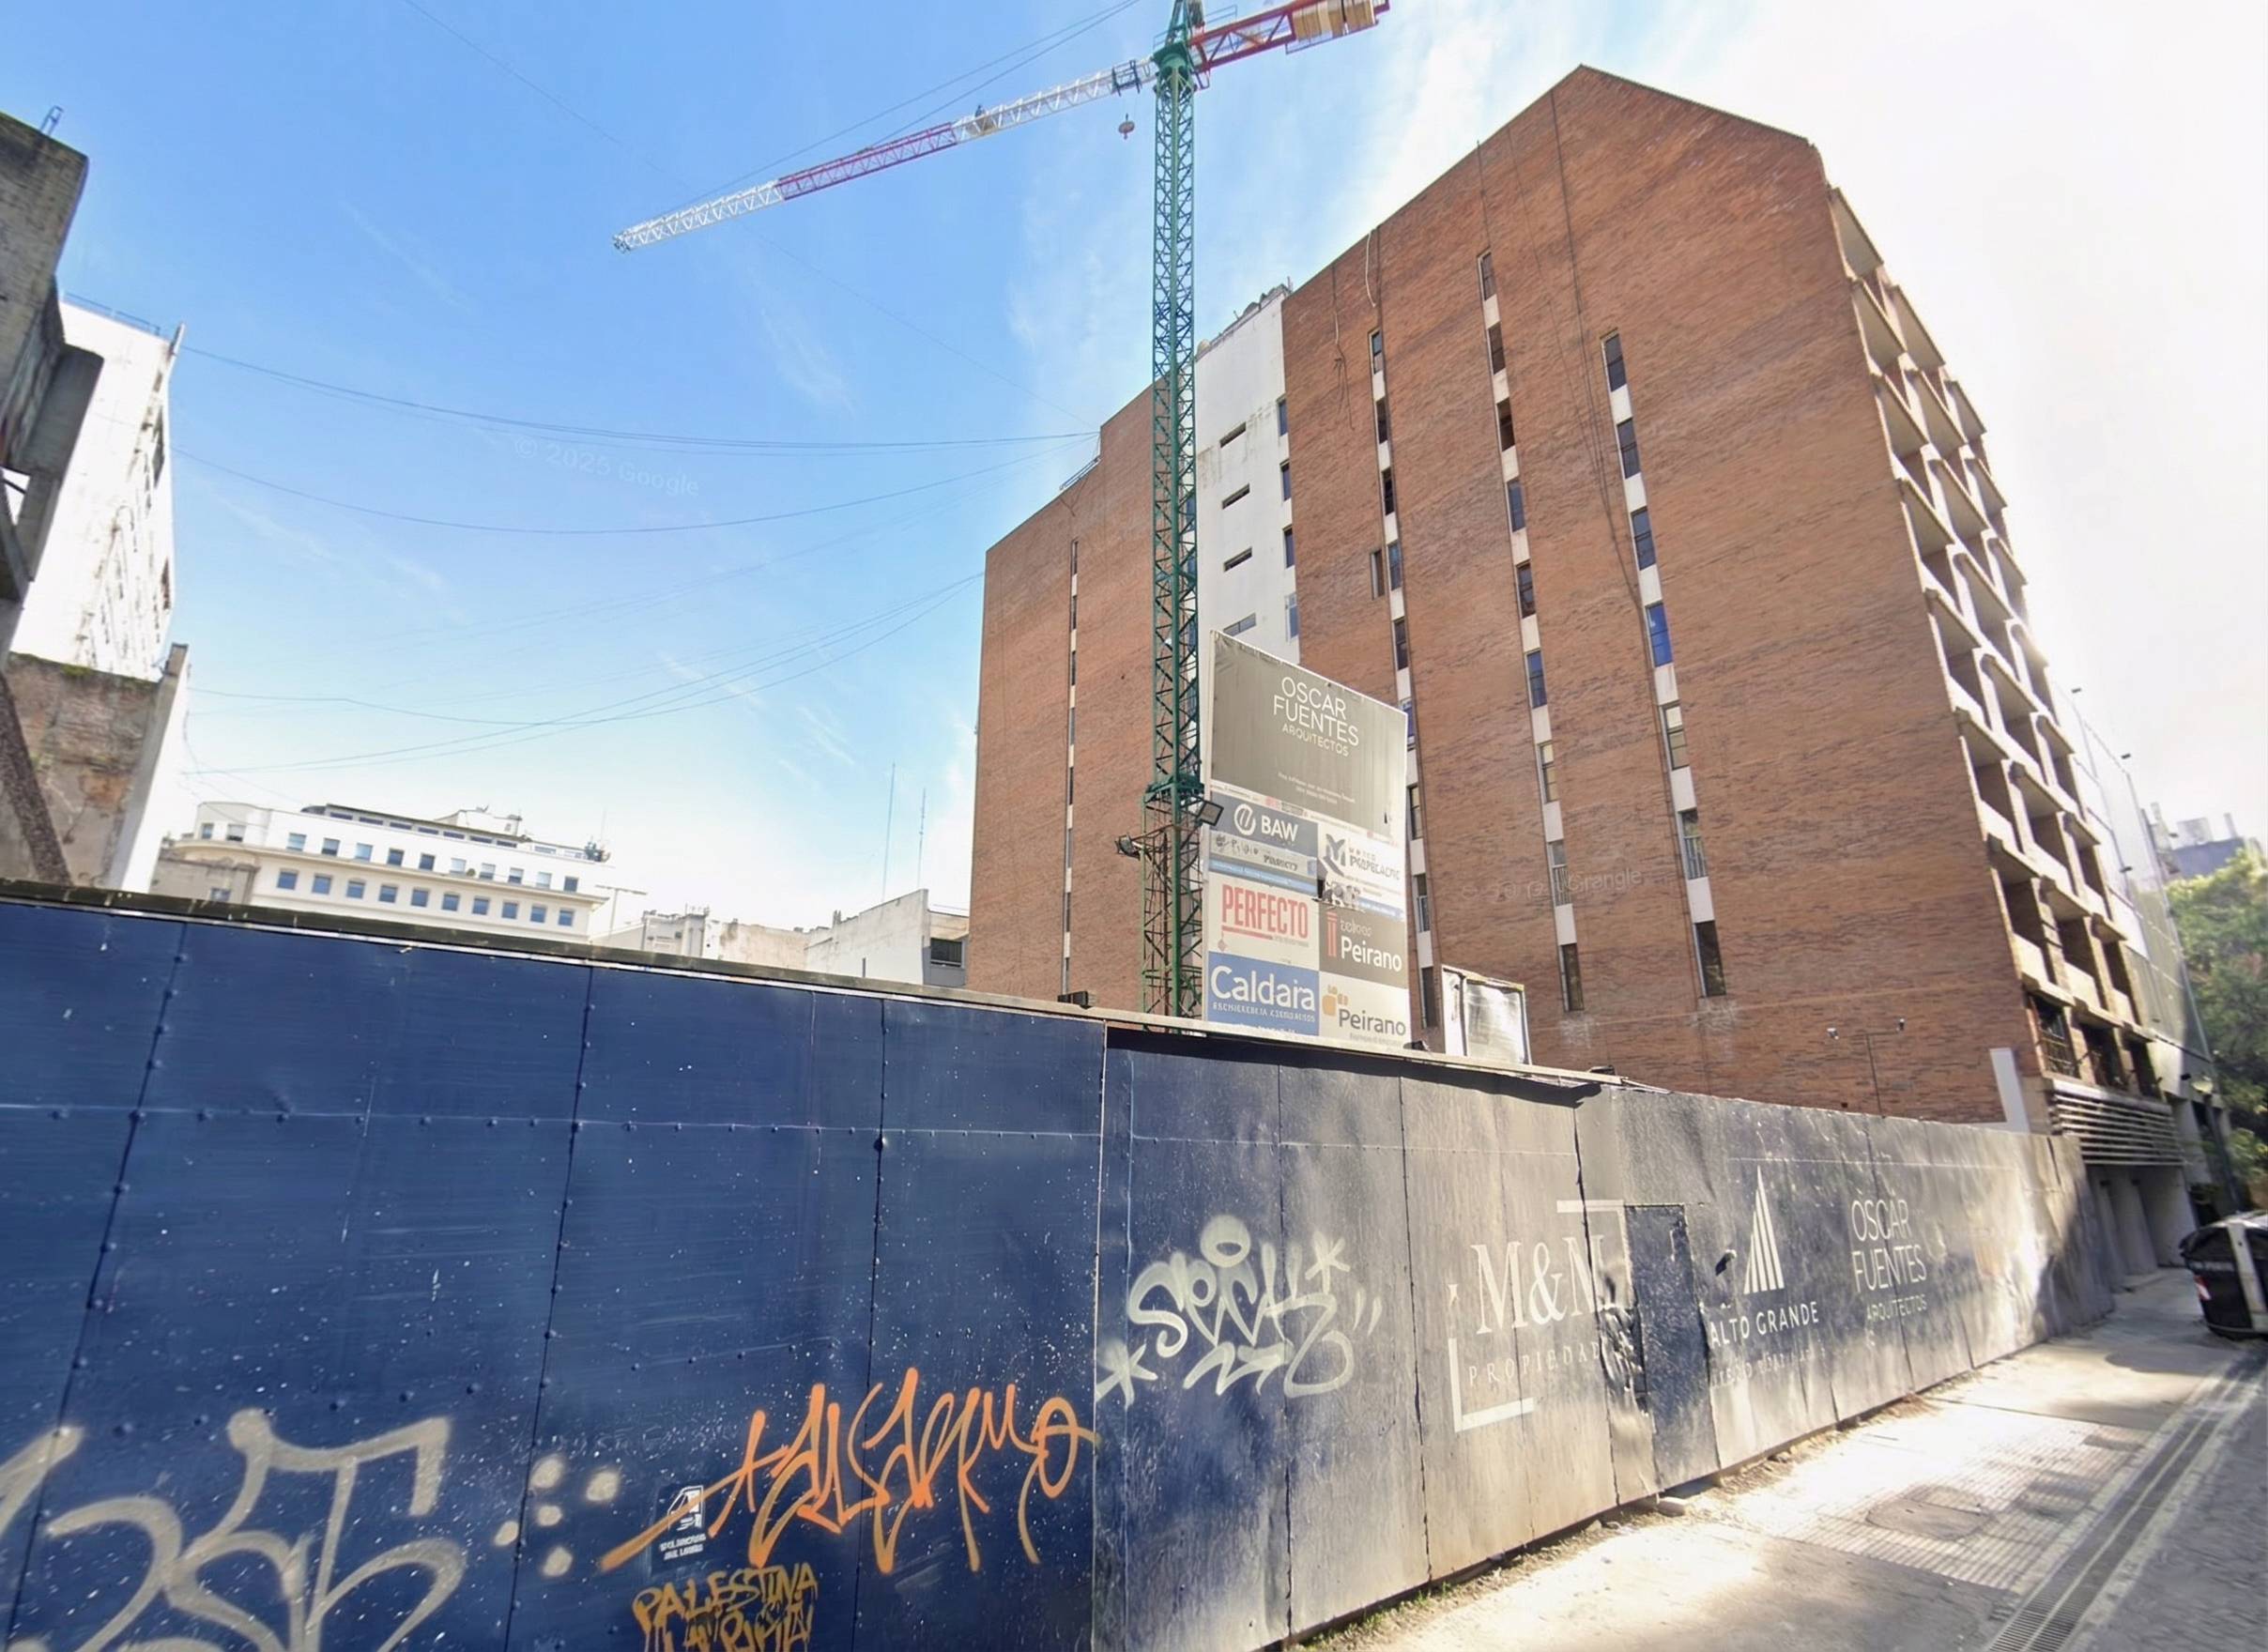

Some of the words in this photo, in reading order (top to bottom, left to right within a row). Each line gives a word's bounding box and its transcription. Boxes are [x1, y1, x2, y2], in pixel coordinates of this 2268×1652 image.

[1281, 677, 1346, 720] OSCAR
[1273, 695, 1359, 746] FUENTES
[1281, 723, 1350, 757] ARQUITECTOS
[1261, 816, 1299, 842] BAW
[1221, 884, 1309, 938] PERFECTO
[1341, 935, 1402, 972] Peirano
[1339, 1008, 1406, 1036] Peirano
[1851, 1199, 1912, 1242] OSCAR
[1851, 1244, 1926, 1293] FUENTES
[1709, 1315, 1751, 1349] ALTO
[1755, 1301, 1819, 1336] GRANDE
[632, 1562, 819, 1634] PALESTINA
